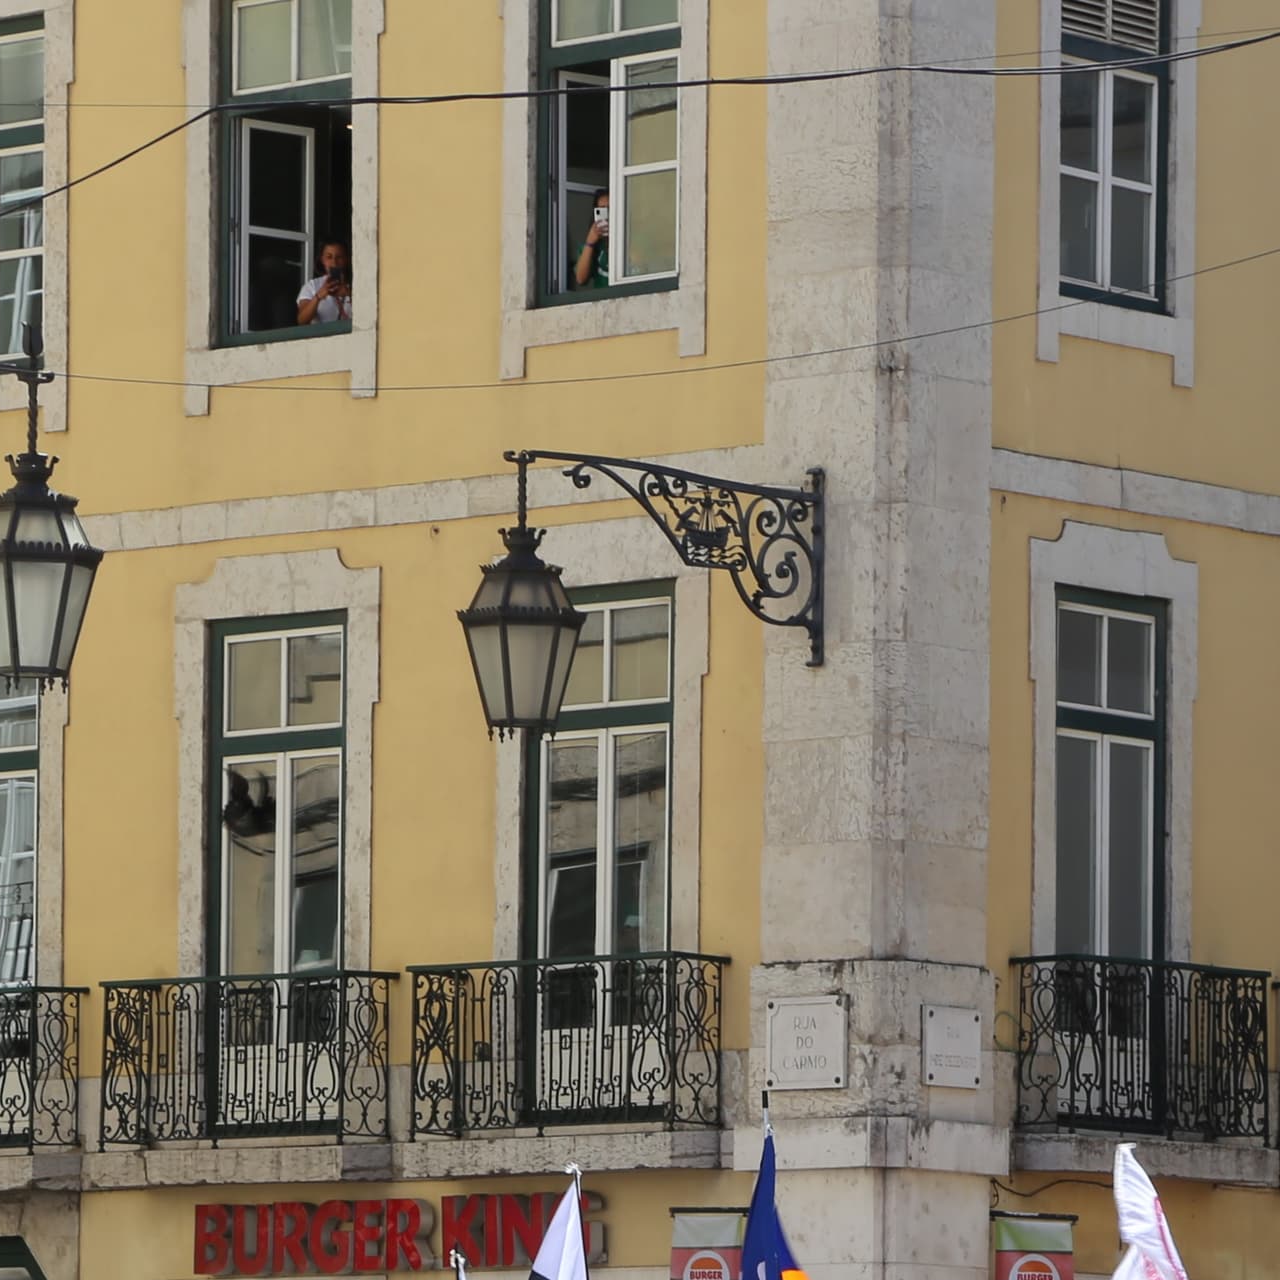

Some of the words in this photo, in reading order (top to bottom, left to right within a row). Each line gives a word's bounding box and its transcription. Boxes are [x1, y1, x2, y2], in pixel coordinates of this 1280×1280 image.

[793, 1015, 817, 1030] RUA
[796, 1036, 814, 1049] DO
[783, 1055, 827, 1070] CARMO
[194, 1198, 422, 1275] BURGER
[441, 1192, 593, 1269] KIN
[690, 1270, 723, 1280] BURGER
